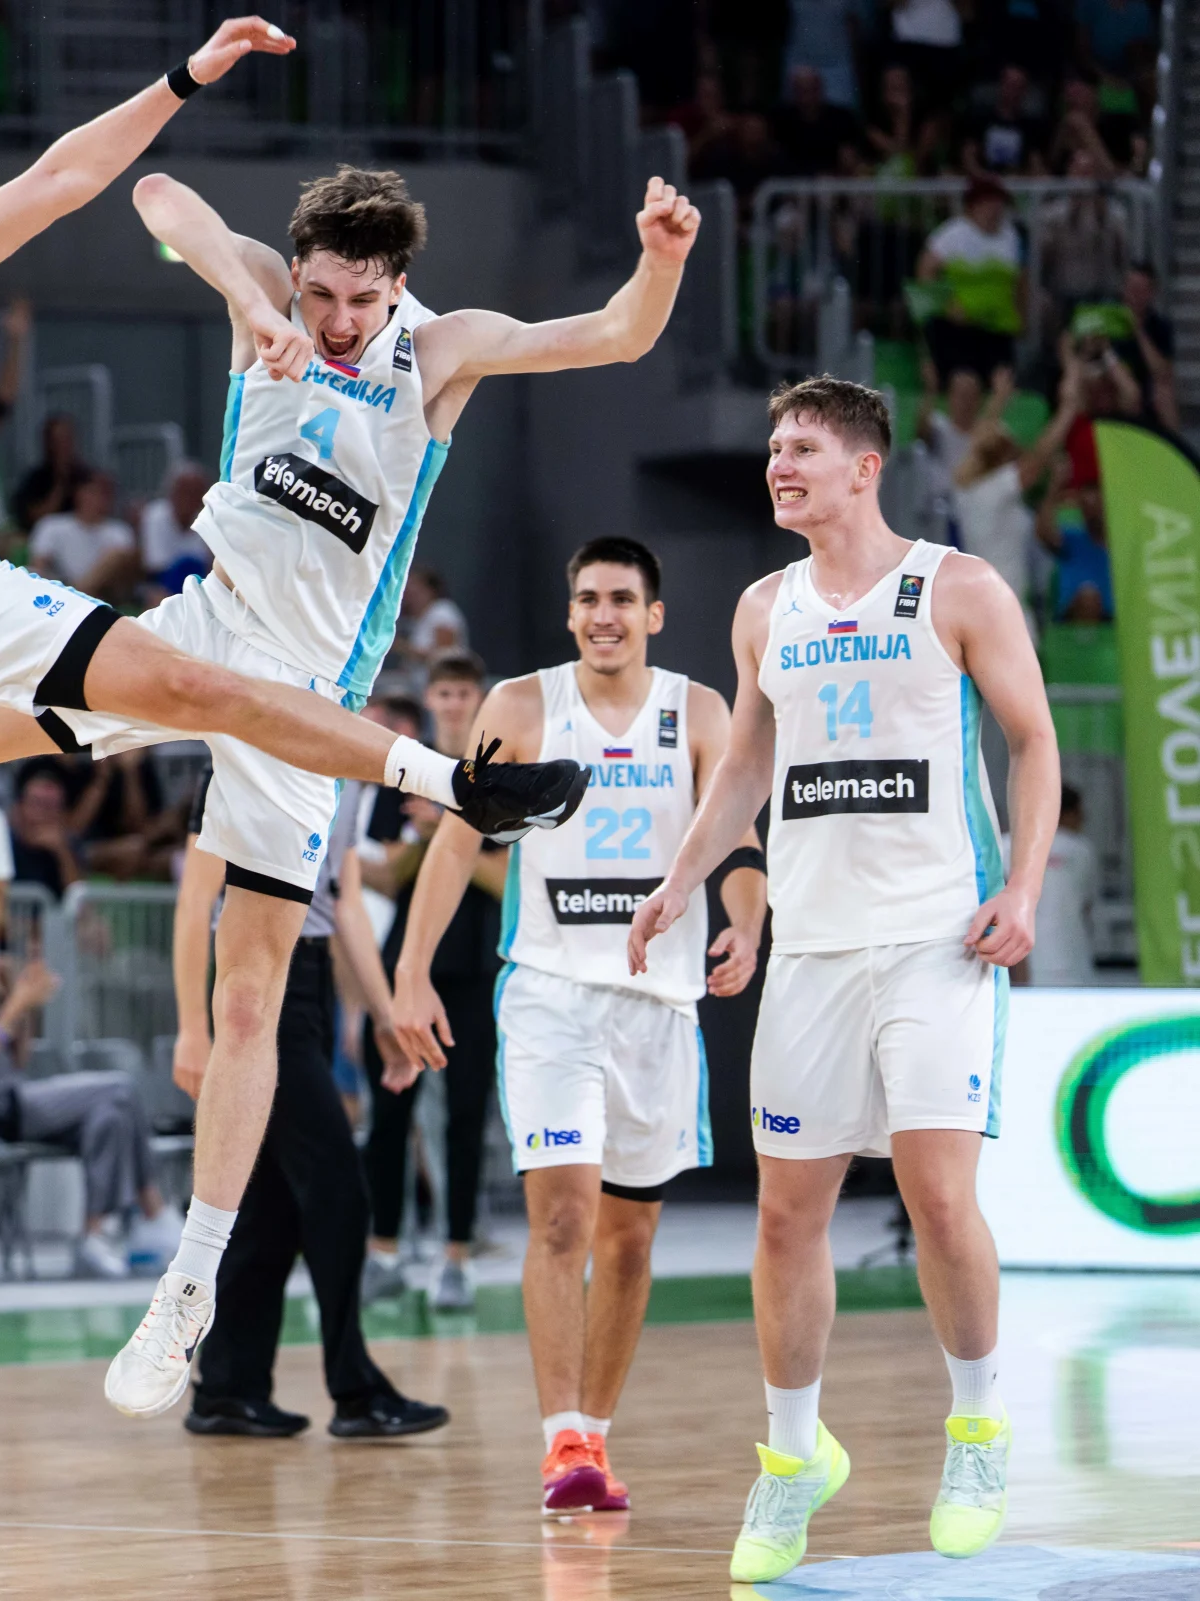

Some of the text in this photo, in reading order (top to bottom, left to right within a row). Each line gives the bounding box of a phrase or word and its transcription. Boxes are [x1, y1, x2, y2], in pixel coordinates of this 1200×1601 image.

[301, 361, 397, 414] VENIJA
[299, 407, 341, 460] 4
[45, 599, 66, 618] KZS
[898, 598, 917, 608] FIBA
[780, 633, 912, 671] SLOVENIJA
[817, 680, 875, 741] 14
[585, 763, 675, 788] OVENIJA
[791, 772, 915, 805] telemach
[585, 807, 652, 860] 22
[301, 849, 319, 863] KZS
[555, 888, 649, 914] telema
[762, 1106, 801, 1135] hse
[543, 1127, 582, 1147] hse
